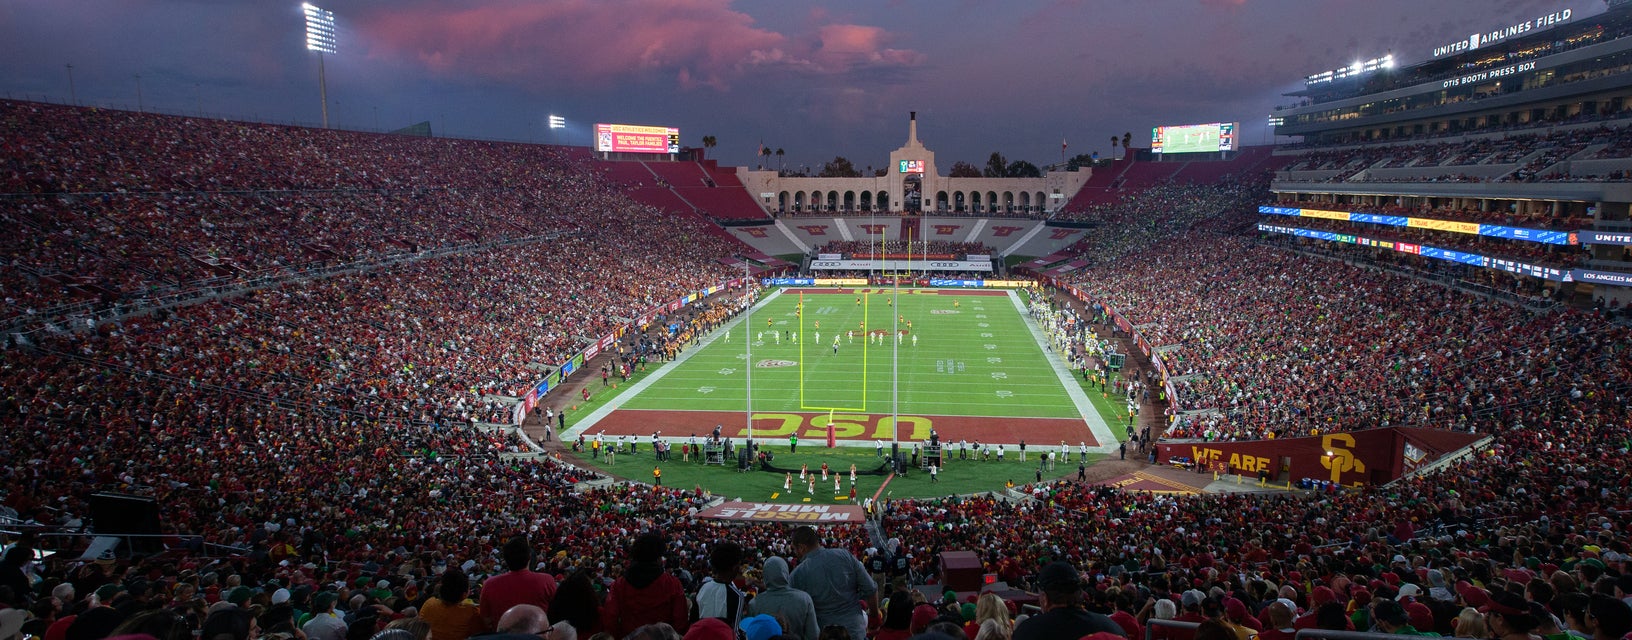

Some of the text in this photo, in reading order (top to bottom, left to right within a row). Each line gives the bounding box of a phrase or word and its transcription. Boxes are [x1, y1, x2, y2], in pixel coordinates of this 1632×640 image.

[1434, 8, 1572, 56] UNITED AIRLINES FIELD
[1443, 61, 1535, 88] OTIS BOOTH PRESS BOX
[1596, 274, 1625, 282] ANGELES
[737, 413, 933, 440] USC
[1191, 445, 1223, 465] WE
[1229, 453, 1271, 474] ARE
[1405, 444, 1418, 460] 34
[714, 509, 850, 521] MUSCLE
[749, 503, 831, 513] MILK
